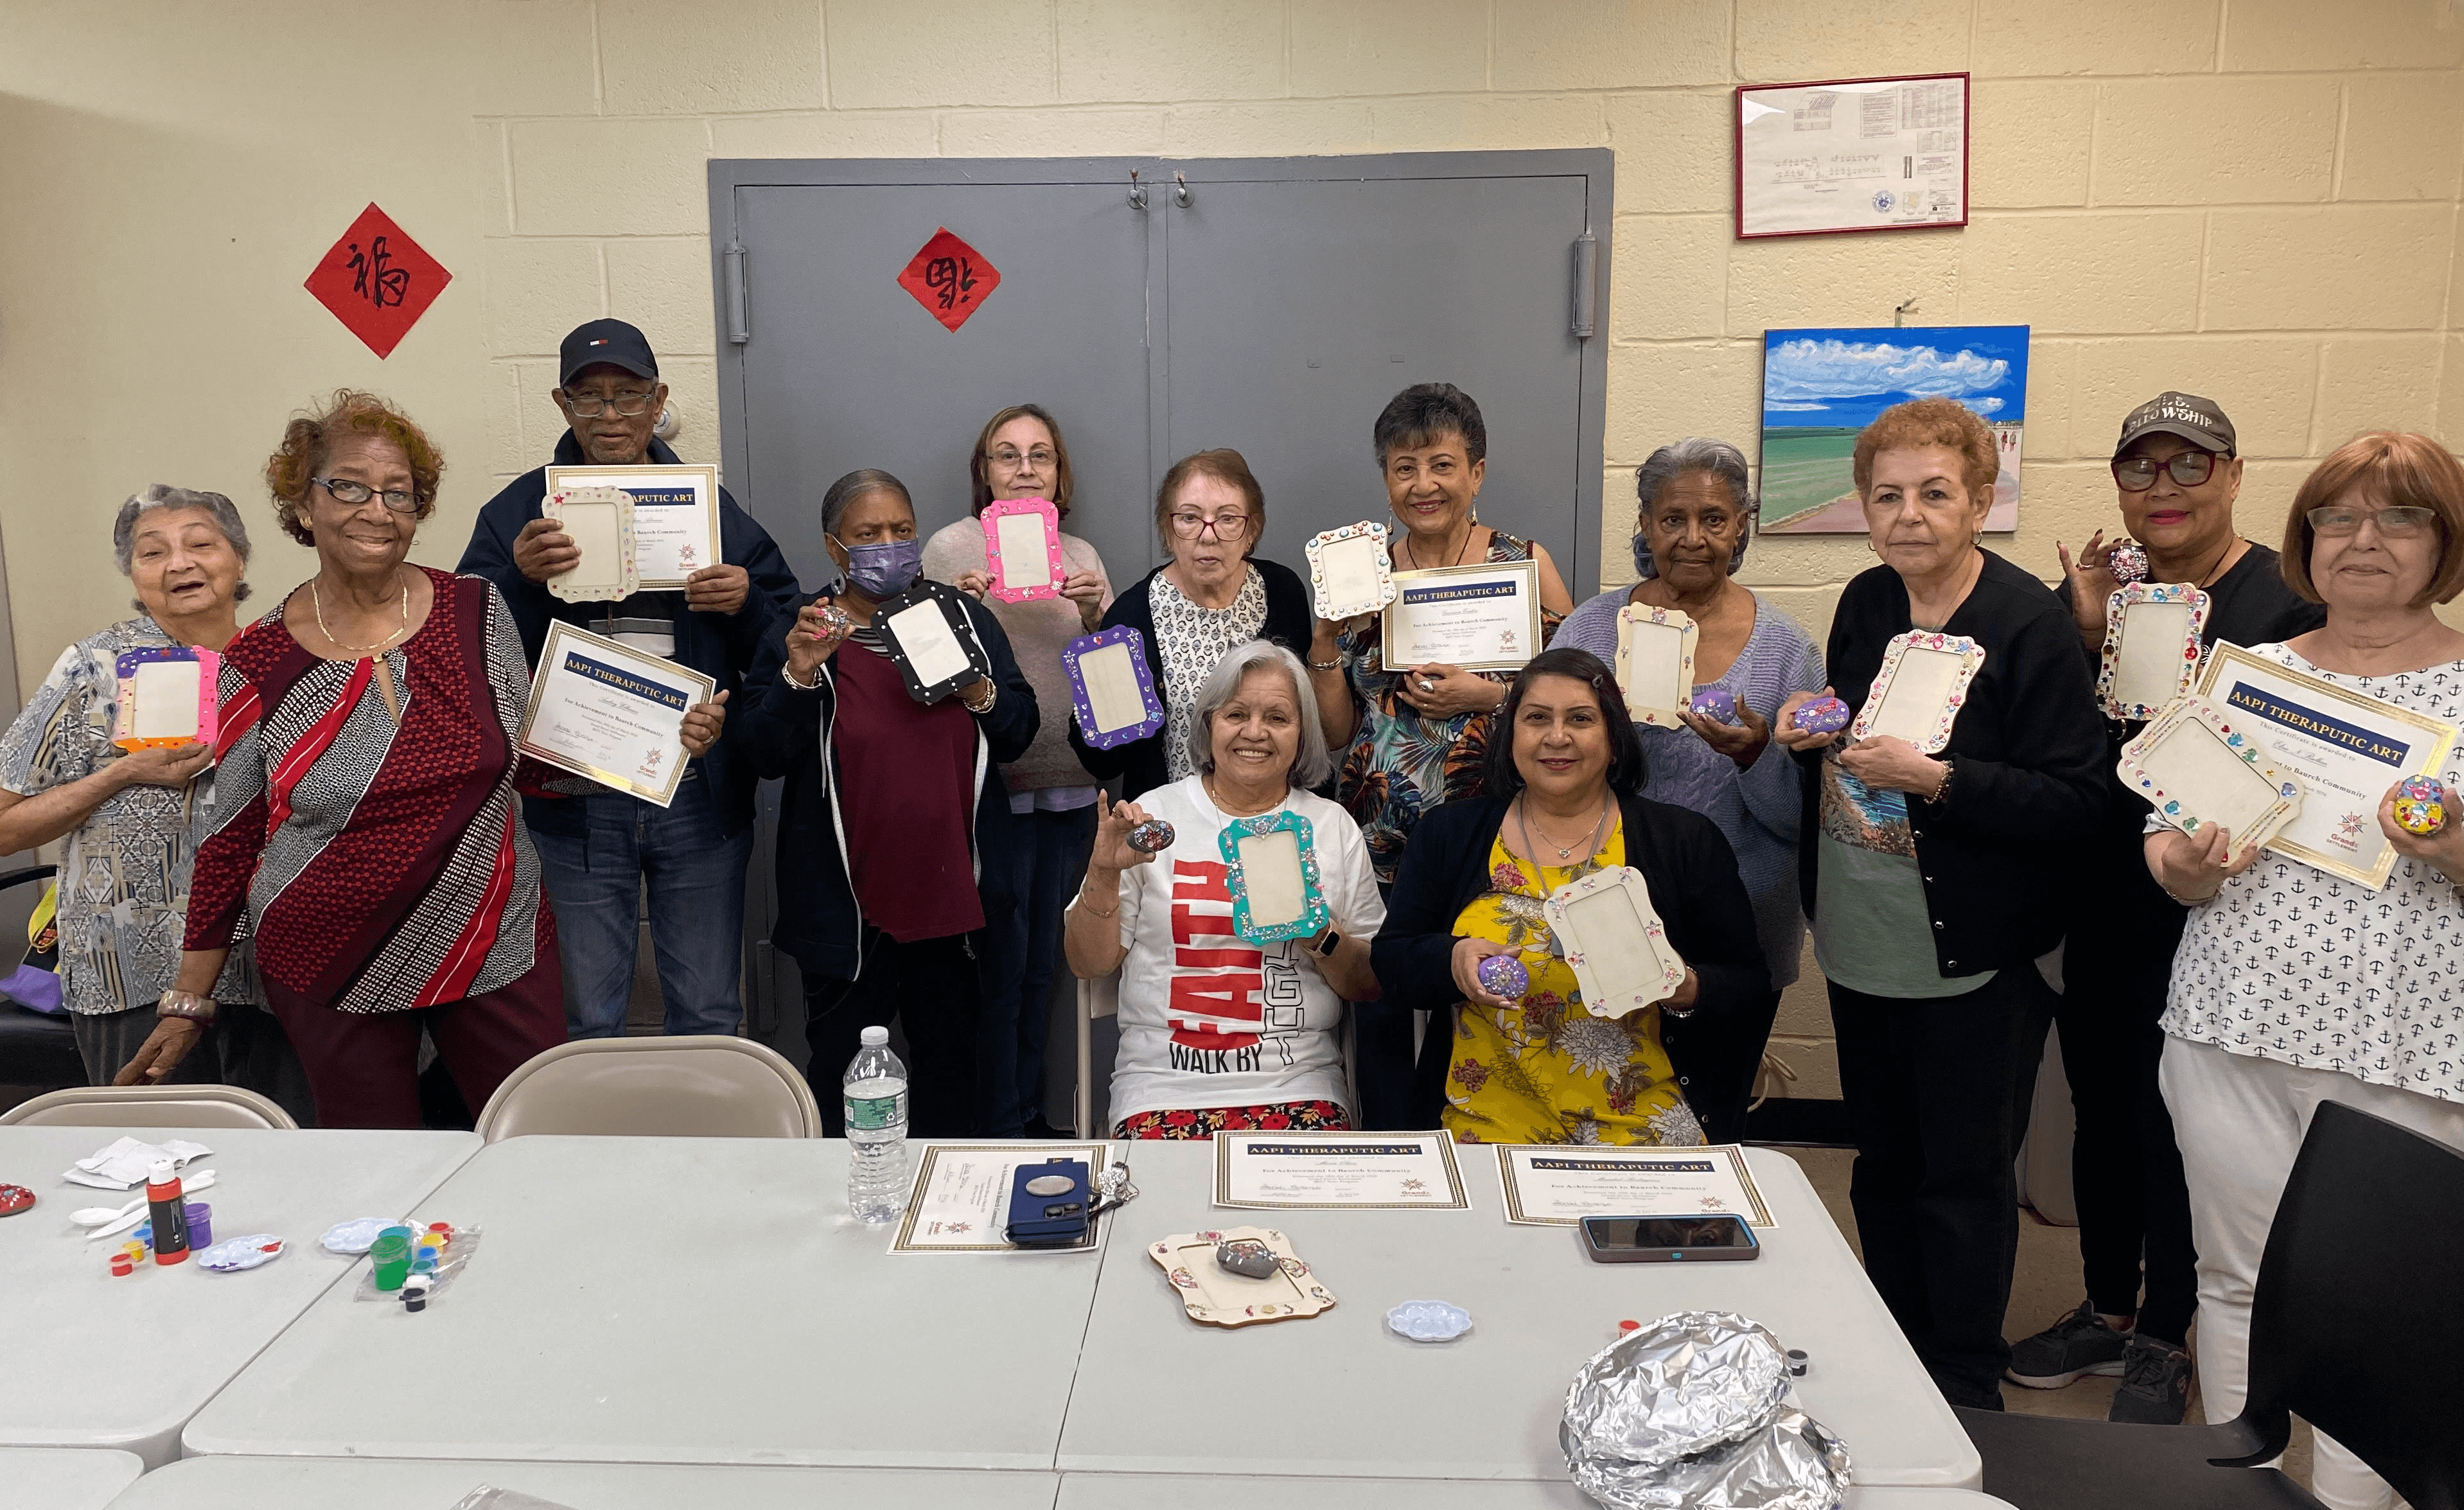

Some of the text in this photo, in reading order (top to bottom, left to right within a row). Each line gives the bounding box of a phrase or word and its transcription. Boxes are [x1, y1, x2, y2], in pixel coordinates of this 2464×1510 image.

[346, 235, 410, 308] 福
[1430, 588, 1492, 599] THERAPUTIC
[567, 660, 685, 707] AAPI THERAPUTIC ART
[574, 701, 607, 717] Achievement
[634, 723, 664, 738] Community
[2230, 692, 2403, 760] AAPI THERAPUTIC ART
[2260, 721, 2273, 730] This
[2275, 728, 2309, 744] Certificate
[2319, 746, 2347, 758] awarded
[2292, 768, 2320, 782] Baurch
[2322, 779, 2366, 800] Community
[2331, 834, 2355, 847] Grand
[1168, 859, 1263, 1050] FAITH
[1169, 1042, 1263, 1075] WALK BY
